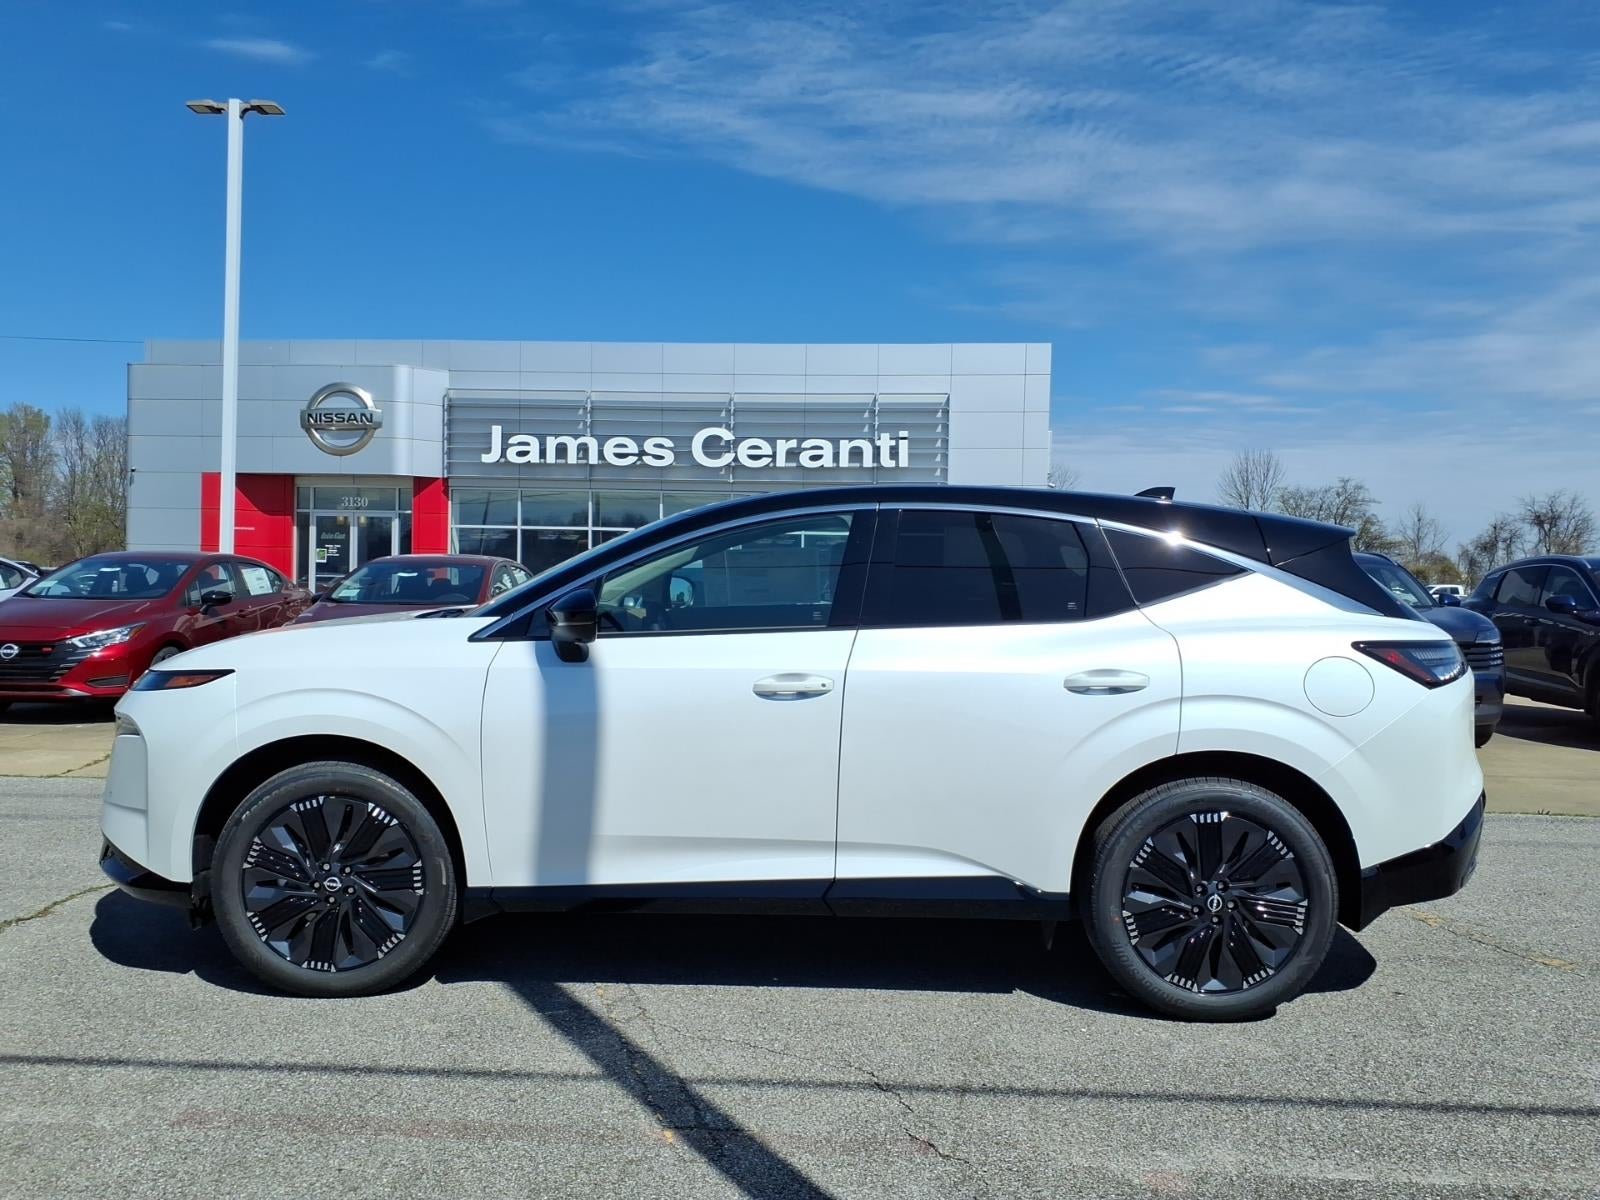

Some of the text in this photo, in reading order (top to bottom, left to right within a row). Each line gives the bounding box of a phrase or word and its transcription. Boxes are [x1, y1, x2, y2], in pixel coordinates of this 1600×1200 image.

[307, 412, 374, 424] NISSAN
[480, 425, 910, 468] James Ceranti
[341, 497, 368, 508] 3130
